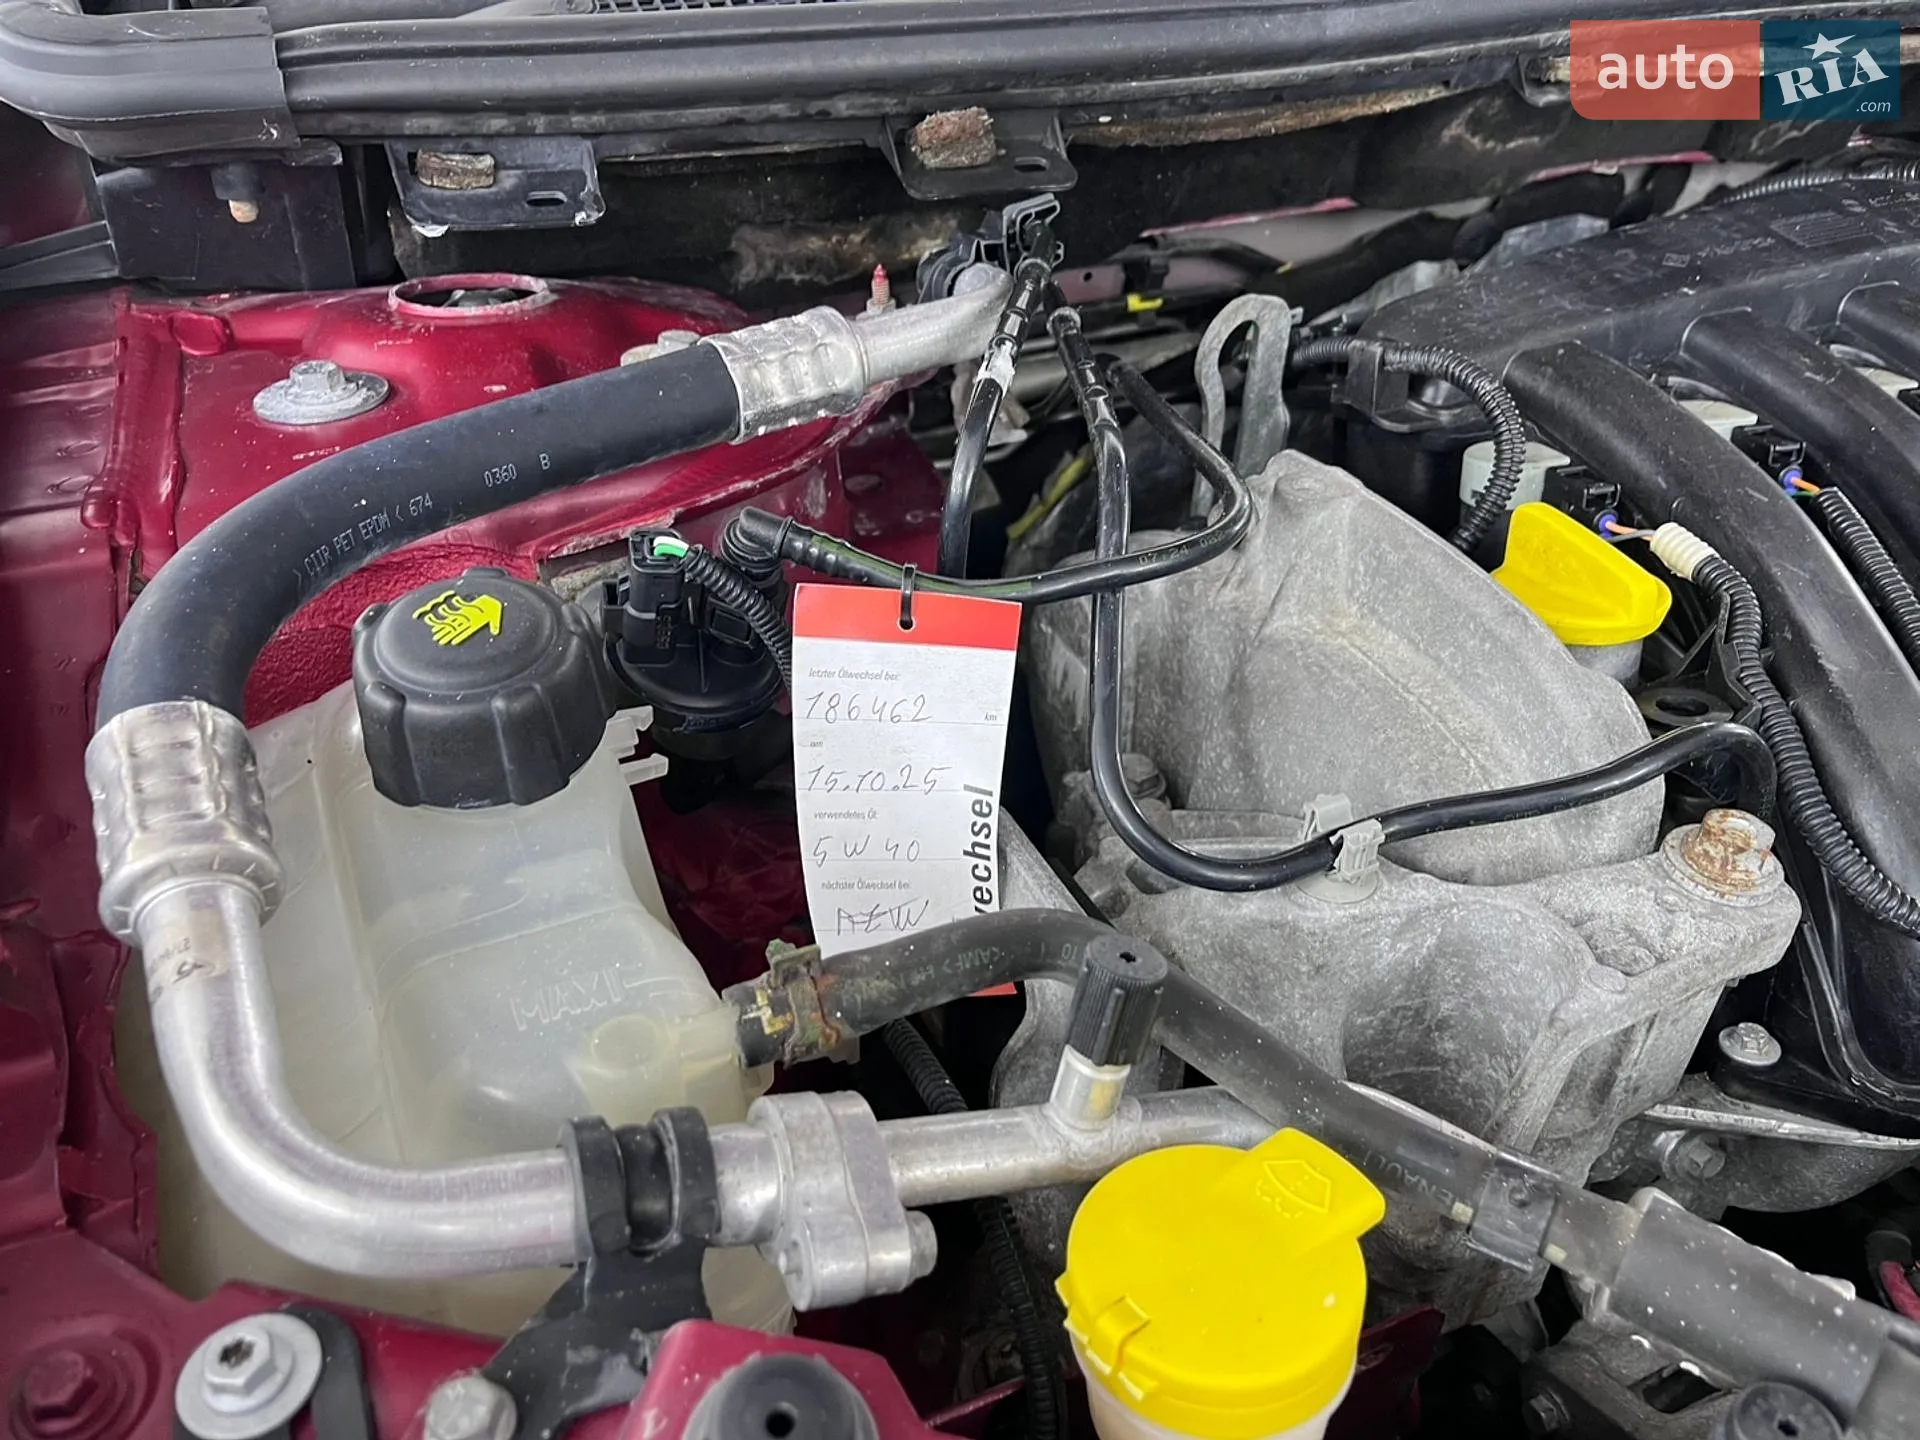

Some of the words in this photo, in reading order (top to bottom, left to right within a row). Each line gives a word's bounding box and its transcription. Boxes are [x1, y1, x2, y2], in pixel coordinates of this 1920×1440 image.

[335, 529, 355, 556] PET
[483, 463, 518, 488] 0360
[539, 453, 551, 470] B
[806, 691, 933, 724] 186462
[984, 712, 998, 722] km
[808, 763, 953, 796] 15.10.25
[510, 968, 623, 1032] MAXI
